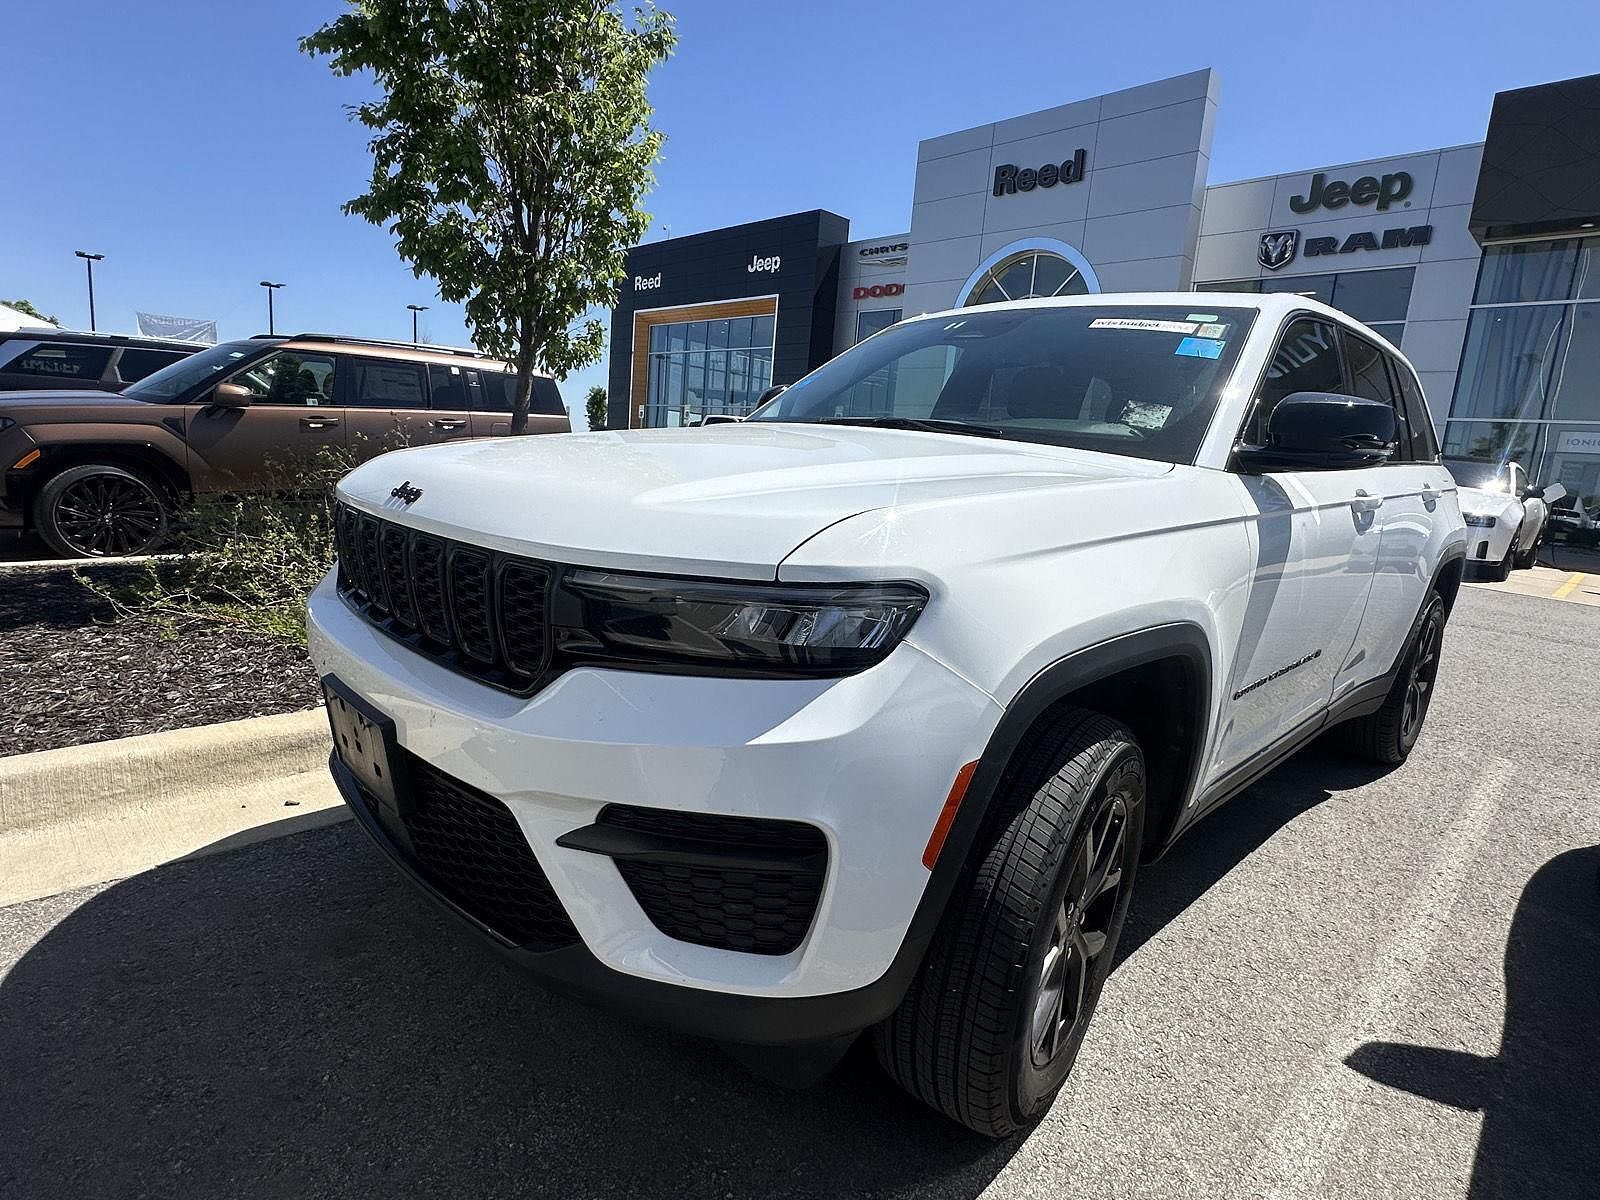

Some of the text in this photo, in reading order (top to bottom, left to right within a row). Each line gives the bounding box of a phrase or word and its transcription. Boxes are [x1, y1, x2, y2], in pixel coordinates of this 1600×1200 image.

[993, 148, 1086, 197] Reed
[1290, 171, 1413, 214] Jeep
[1303, 224, 1433, 257] RAM
[747, 254, 781, 273] Jeep
[634, 272, 662, 291] Reed
[852, 283, 906, 300] DOD
